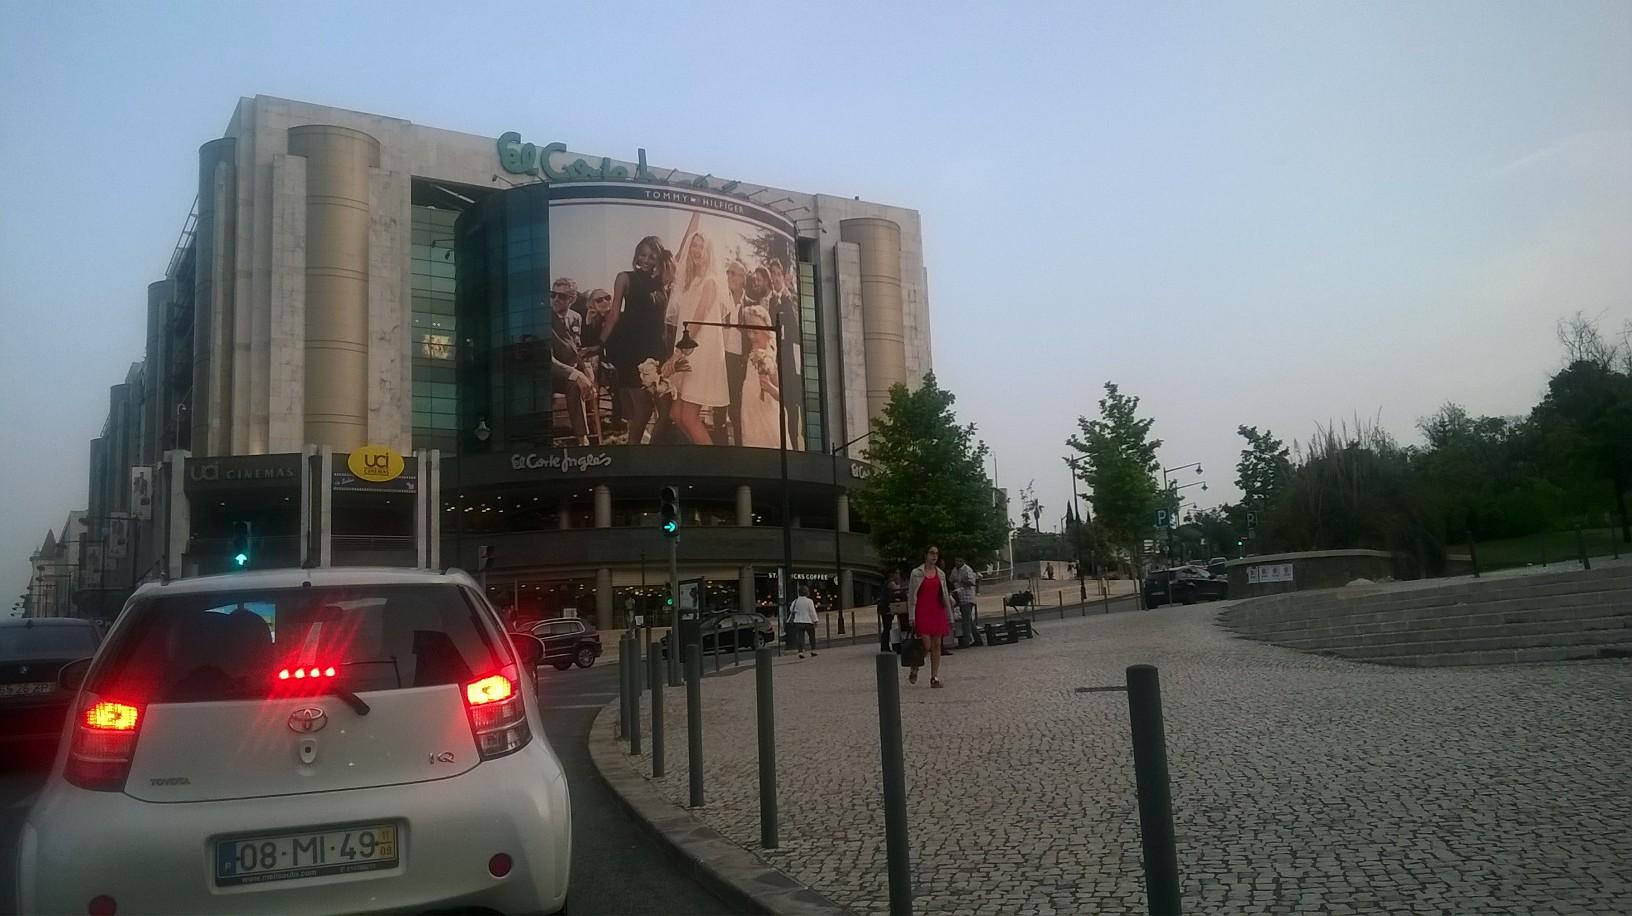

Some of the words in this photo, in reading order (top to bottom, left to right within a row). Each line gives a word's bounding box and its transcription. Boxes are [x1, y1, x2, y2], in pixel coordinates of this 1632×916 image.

[497, 131, 539, 176] El
[645, 190, 688, 202] TOMMY
[702, 198, 744, 215] HILFIGER
[511, 454, 526, 470] El
[526, 453, 561, 469] Corte
[226, 467, 297, 480] CINEMAS
[768, 572, 805, 580] STCKS
[806, 573, 828, 581] COFFEE
[150, 777, 191, 787] TOYOTA
